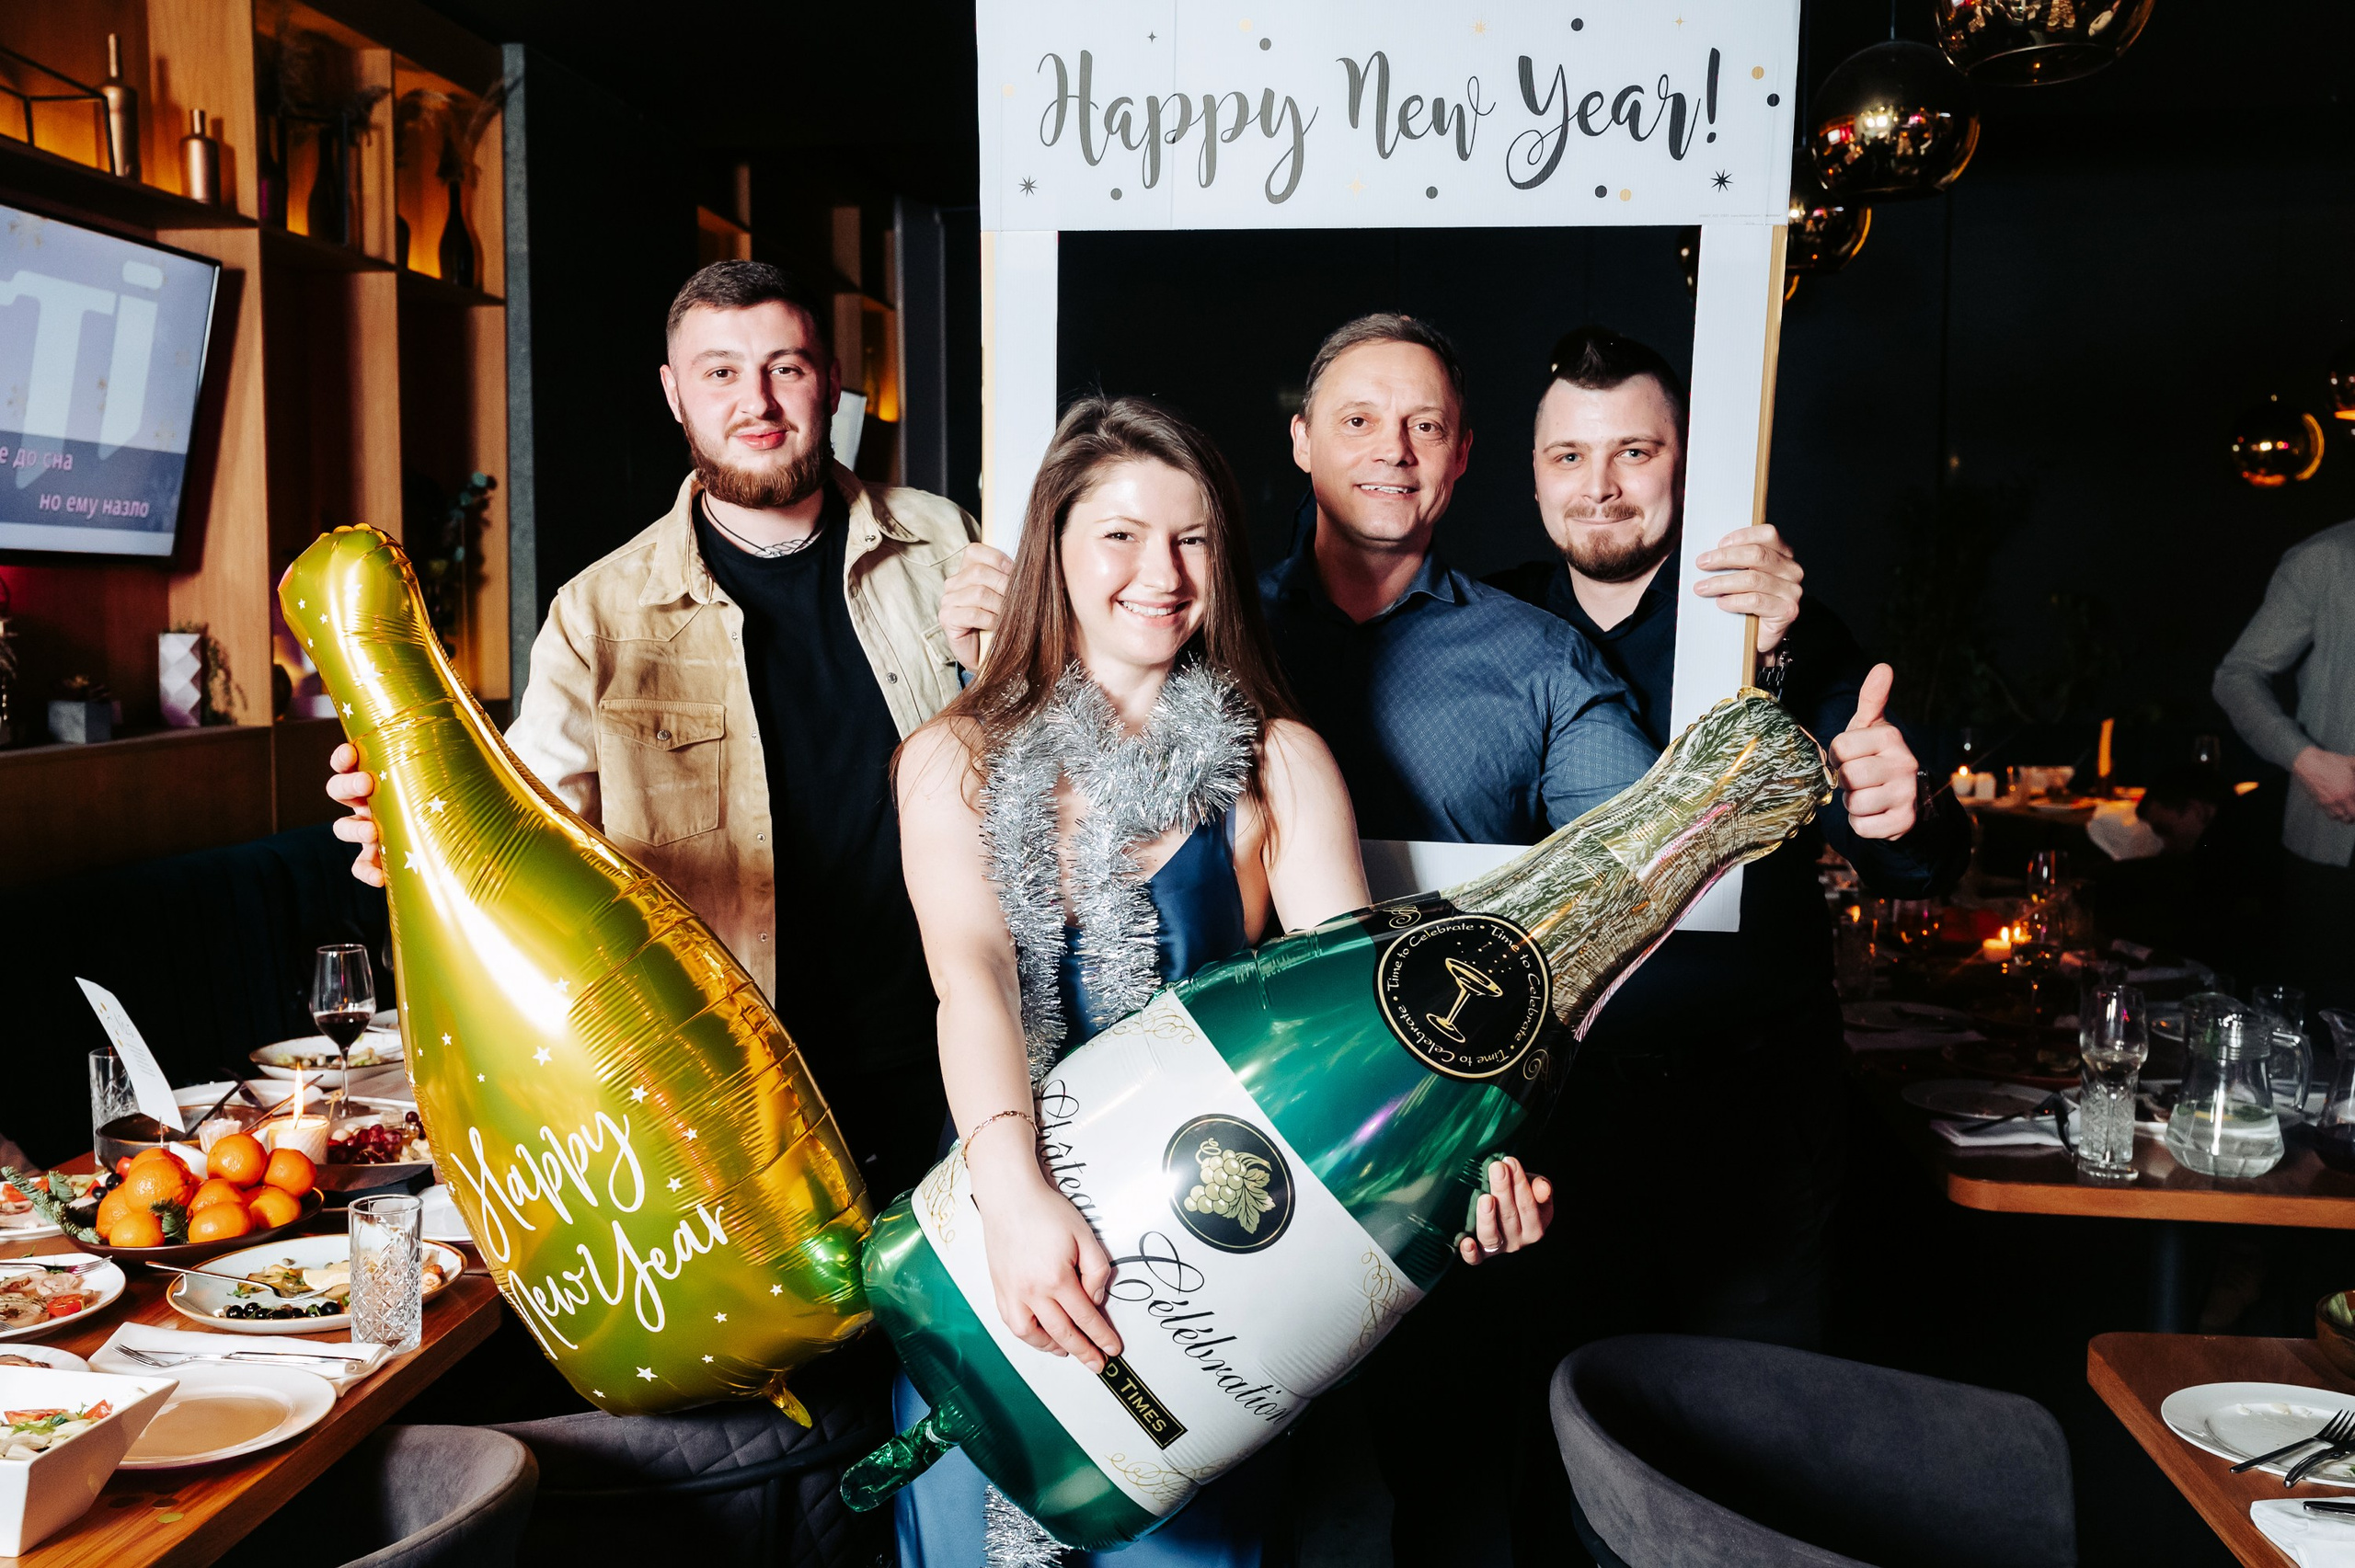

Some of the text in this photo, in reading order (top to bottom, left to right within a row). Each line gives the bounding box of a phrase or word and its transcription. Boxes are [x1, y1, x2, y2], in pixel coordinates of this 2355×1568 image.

[1038, 48, 1720, 205] Happy New Year!
[12, 447, 37, 469] до
[42, 452, 74, 471] сна
[40, 493, 150, 520] но ему назло
[1387, 922, 1475, 992] Time to Celebrate
[1490, 924, 1542, 1042] Time to Celebrate
[1397, 1004, 1510, 1067] Time to Celebrate
[450, 1111, 646, 1264] Happy
[499, 1204, 729, 1361] New Year
[1106, 1230, 1292, 1425] Célébration
[1120, 1378, 1167, 1432] TIMES
